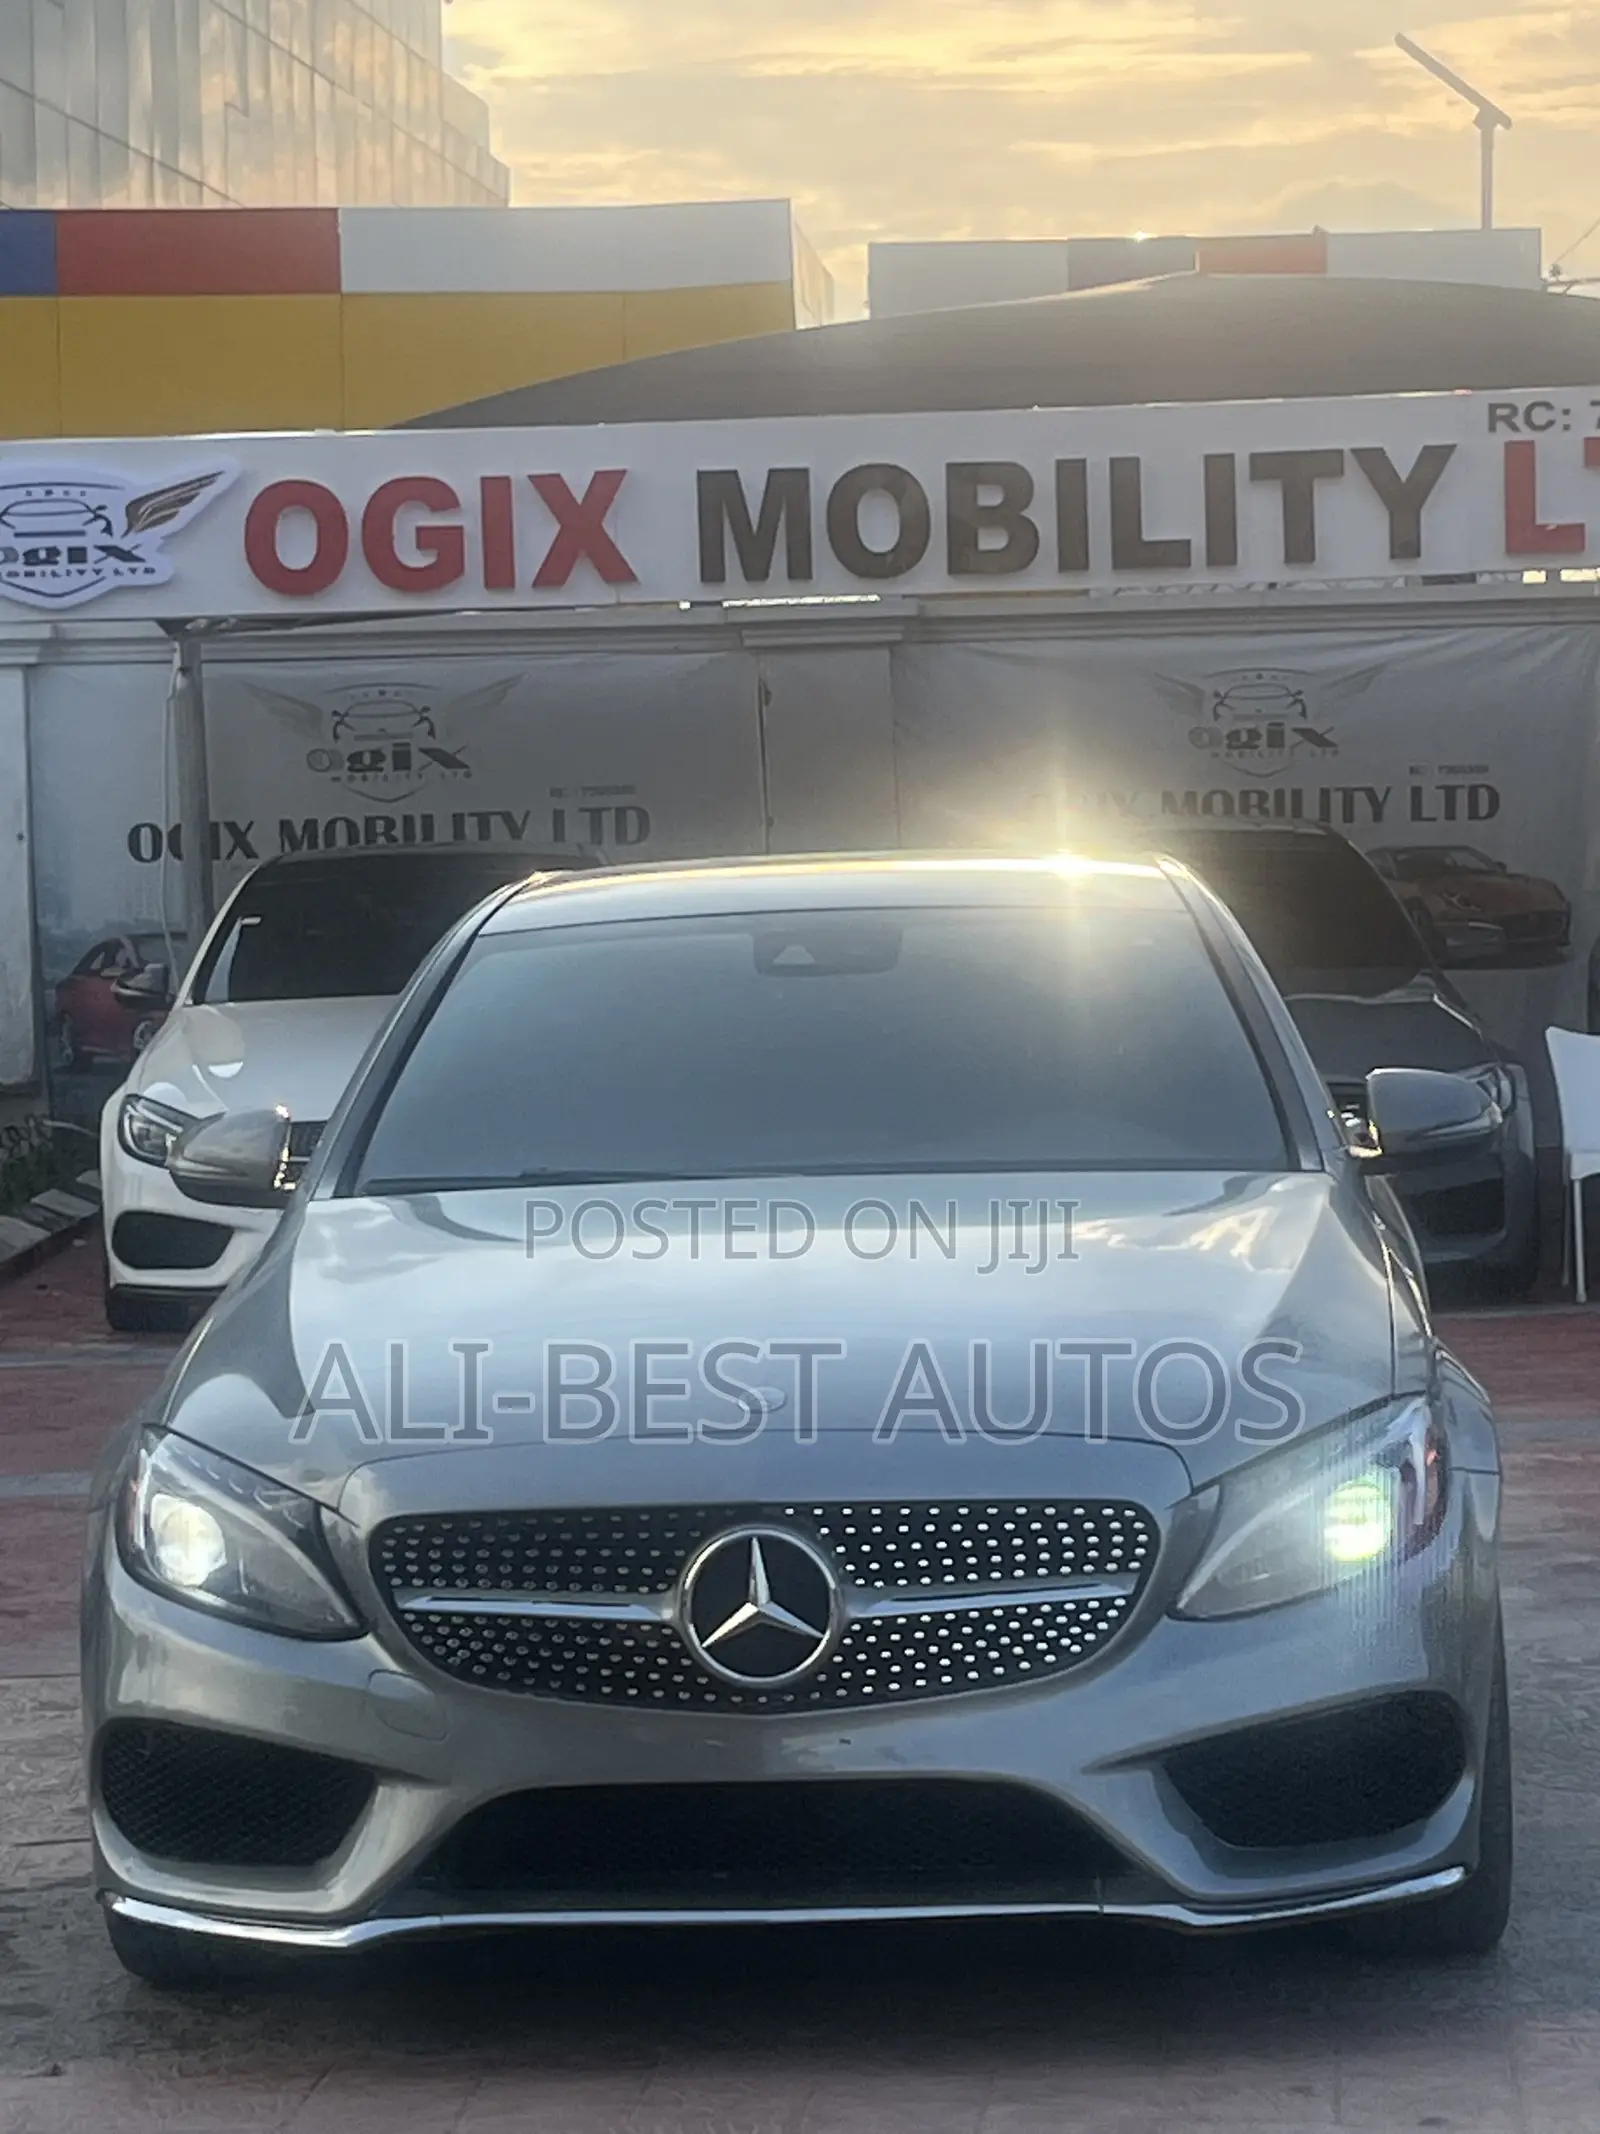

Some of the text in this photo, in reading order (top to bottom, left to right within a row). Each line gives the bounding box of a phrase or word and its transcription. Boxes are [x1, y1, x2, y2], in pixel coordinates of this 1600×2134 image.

[1488, 401, 1571, 433] RC:
[244, 437, 1600, 597] OGIX MOBILITY L
[1161, 785, 1392, 823] MOBILITY
[1410, 783, 1500, 821] LTD
